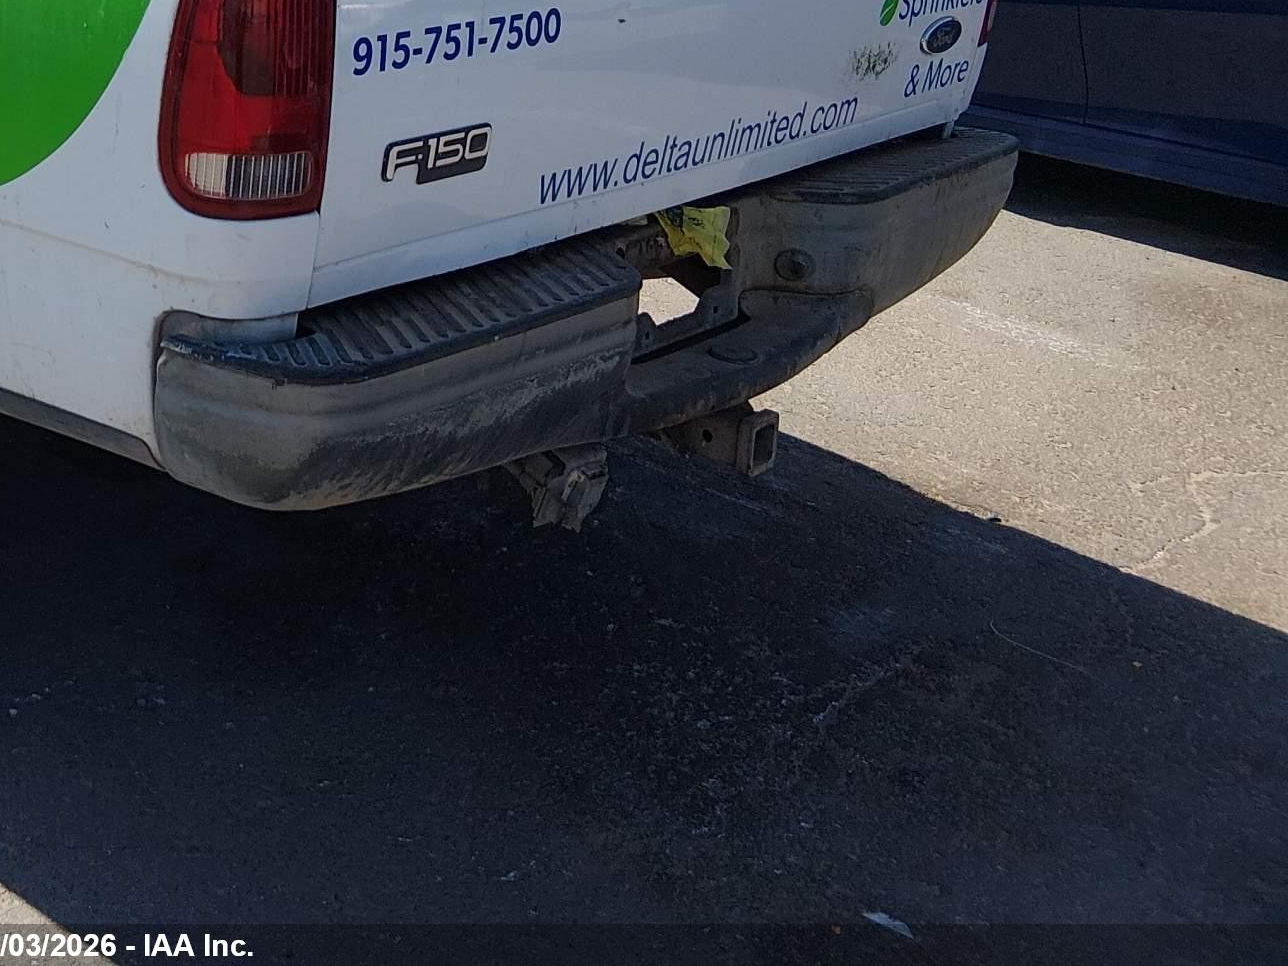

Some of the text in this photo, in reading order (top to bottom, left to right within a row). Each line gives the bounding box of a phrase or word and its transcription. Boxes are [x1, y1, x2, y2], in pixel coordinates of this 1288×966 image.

[352, 7, 562, 76] 915-751-7500
[903, 58, 969, 98] & More
[538, 96, 858, 205] www.deltaunlimited.com
